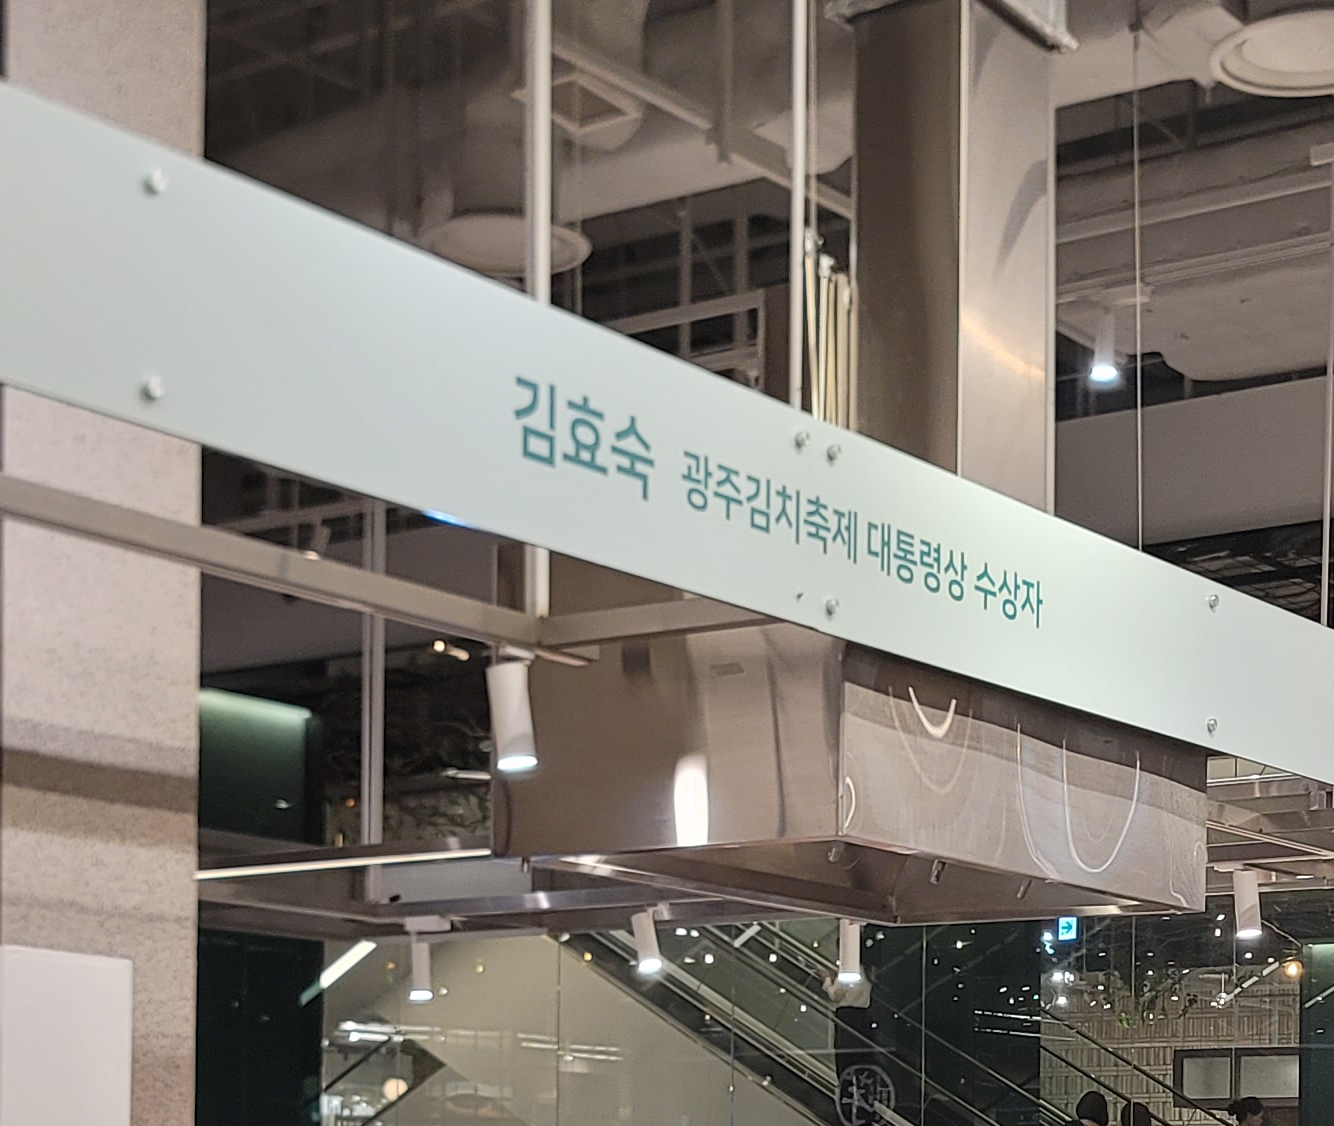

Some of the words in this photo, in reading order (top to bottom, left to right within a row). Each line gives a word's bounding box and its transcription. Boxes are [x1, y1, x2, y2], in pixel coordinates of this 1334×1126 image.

[513, 375, 656, 501] 김효숙
[680, 449, 859, 565] 광주김치축제
[866, 520, 968, 603] 대통령상
[973, 562, 1045, 630] 수상자
